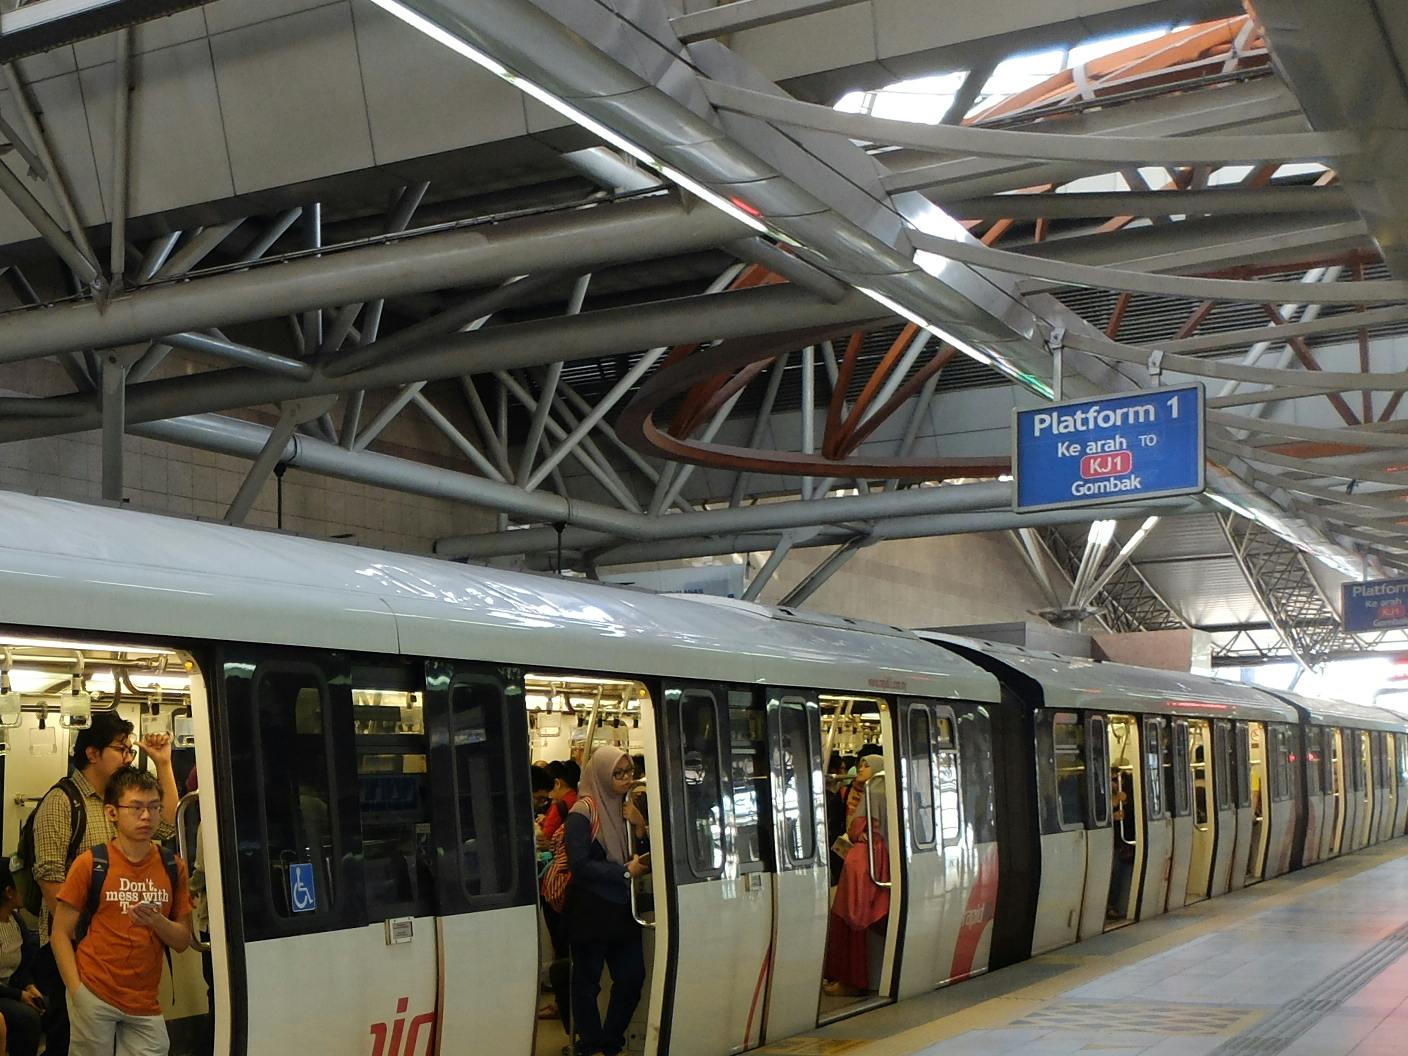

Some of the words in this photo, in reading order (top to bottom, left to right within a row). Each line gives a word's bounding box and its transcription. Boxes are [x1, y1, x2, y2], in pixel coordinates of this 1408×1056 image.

[1033, 403, 1156, 437] Platform
[1166, 395, 1180, 419] 1
[1057, 441, 1081, 458] Ke
[1086, 434, 1127, 455] arah
[1138, 434, 1158, 447] TO
[1089, 456, 1122, 475] KJ1
[1071, 474, 1142, 497] Gombak
[119, 877, 154, 892] Don't
[105, 891, 139, 902] mess
[142, 888, 169, 903] with
